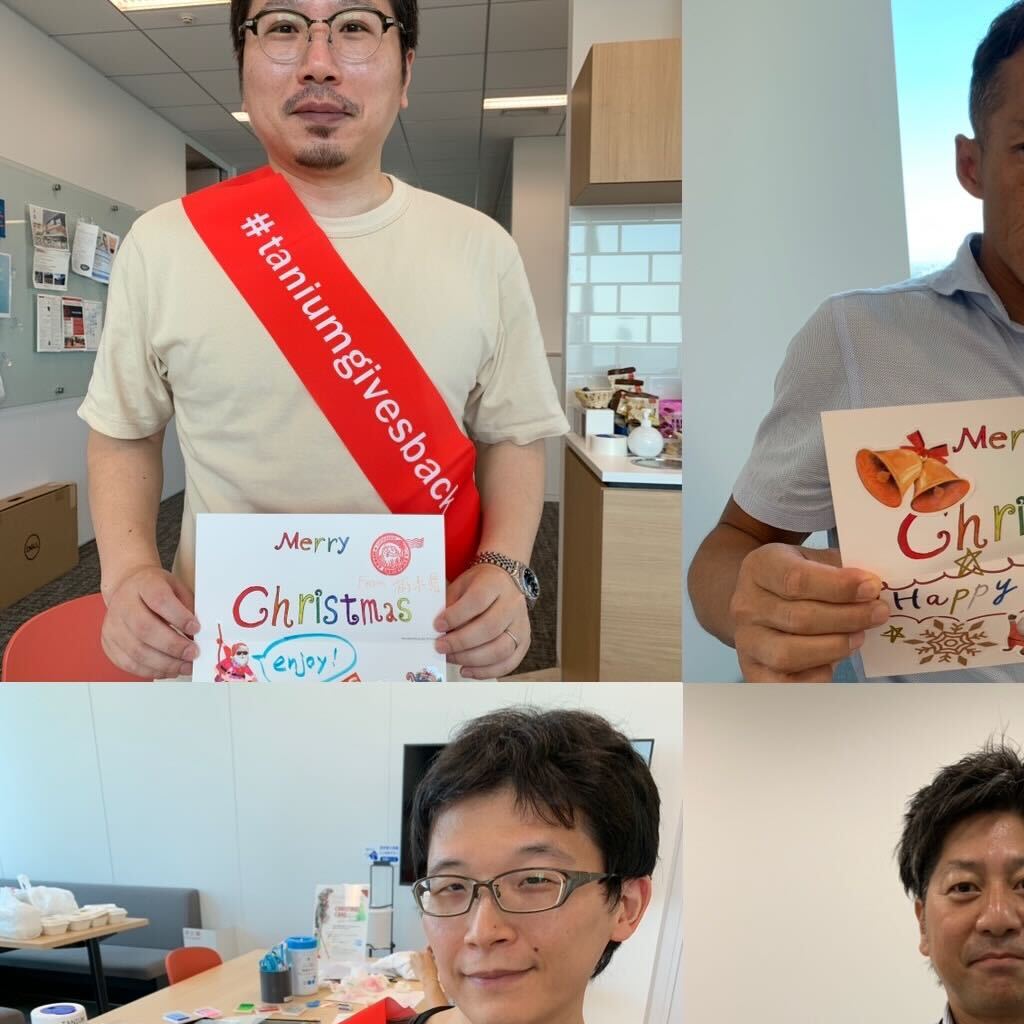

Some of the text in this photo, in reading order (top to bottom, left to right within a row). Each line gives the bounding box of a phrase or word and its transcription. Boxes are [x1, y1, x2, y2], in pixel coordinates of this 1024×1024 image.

[274, 532, 350, 554] Merry
[232, 585, 413, 629] Christmas
[893, 576, 1018, 614] Happy
